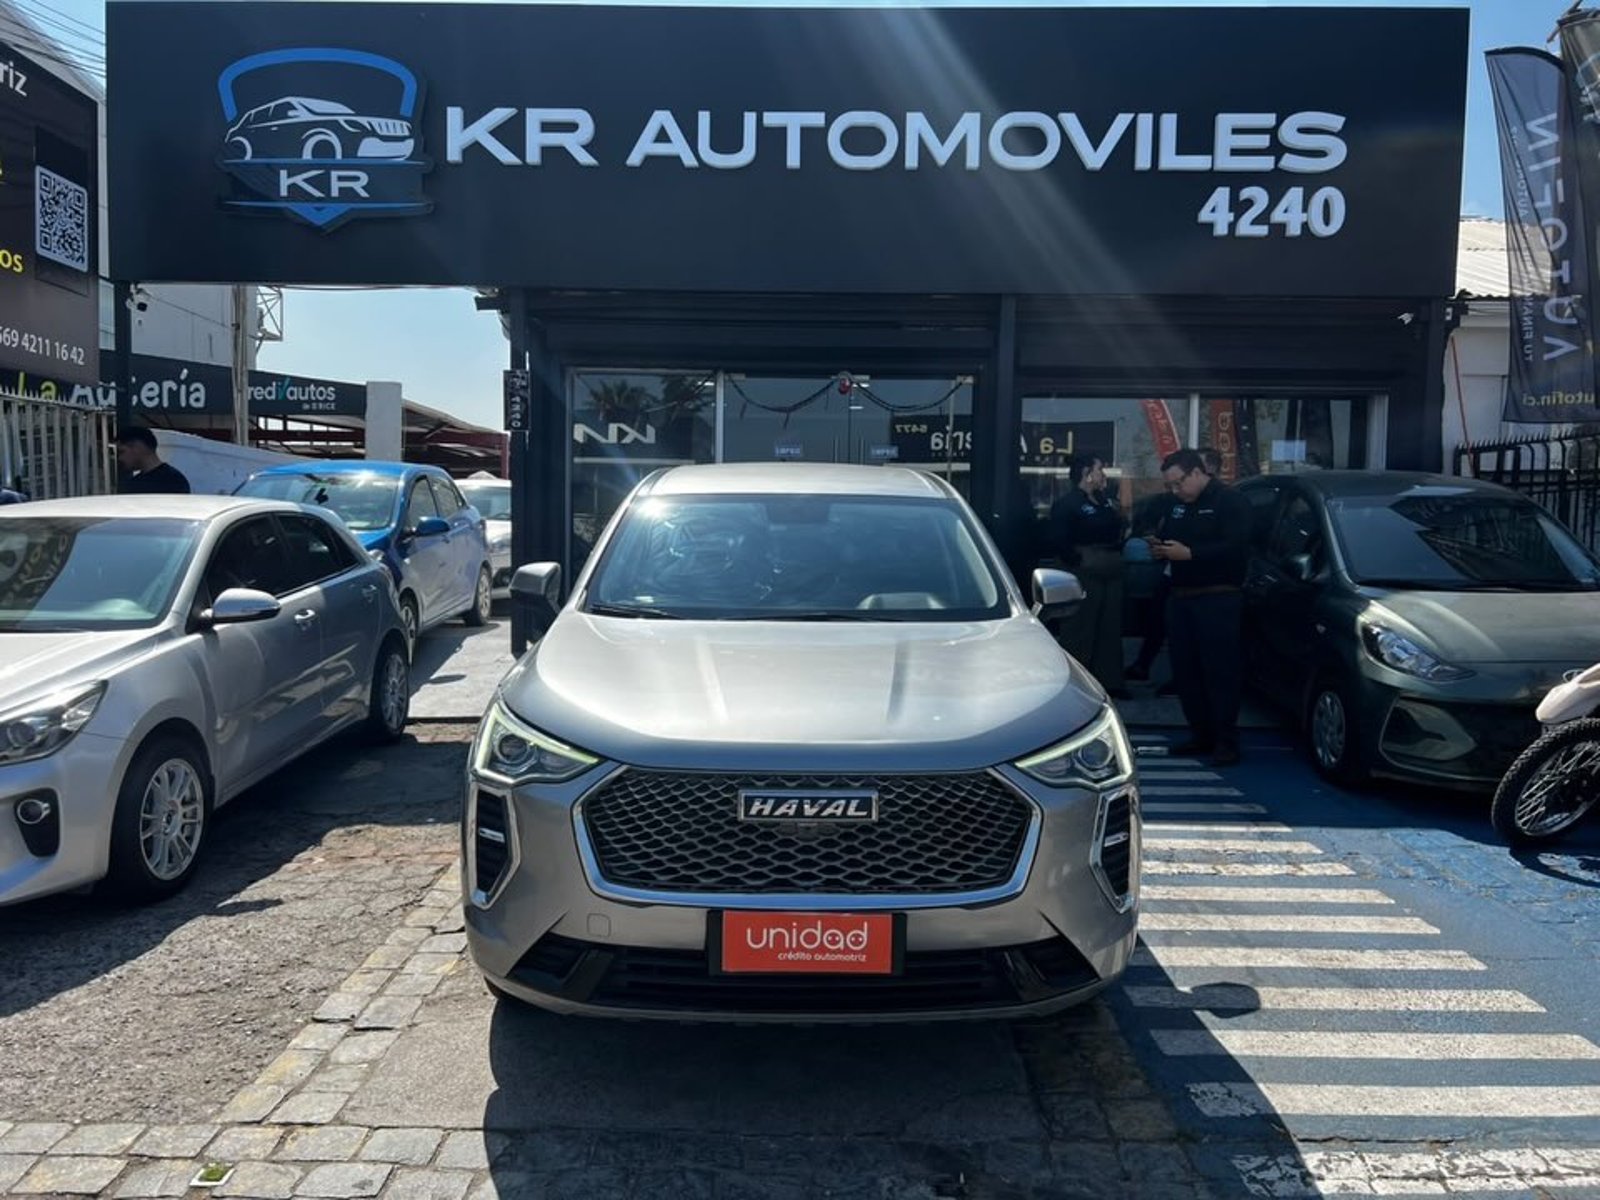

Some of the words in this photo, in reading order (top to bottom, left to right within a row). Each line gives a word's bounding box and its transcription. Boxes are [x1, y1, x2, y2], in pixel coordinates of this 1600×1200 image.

[446, 106, 599, 166] KR
[625, 110, 1348, 173] AUTOMOVILES
[279, 169, 370, 197] KR
[1198, 186, 1346, 237] 4240
[21, 333, 50, 357] 4211
[749, 799, 868, 816] HAVAL
[746, 920, 868, 951] unidad
[814, 953, 867, 962] automotriz
